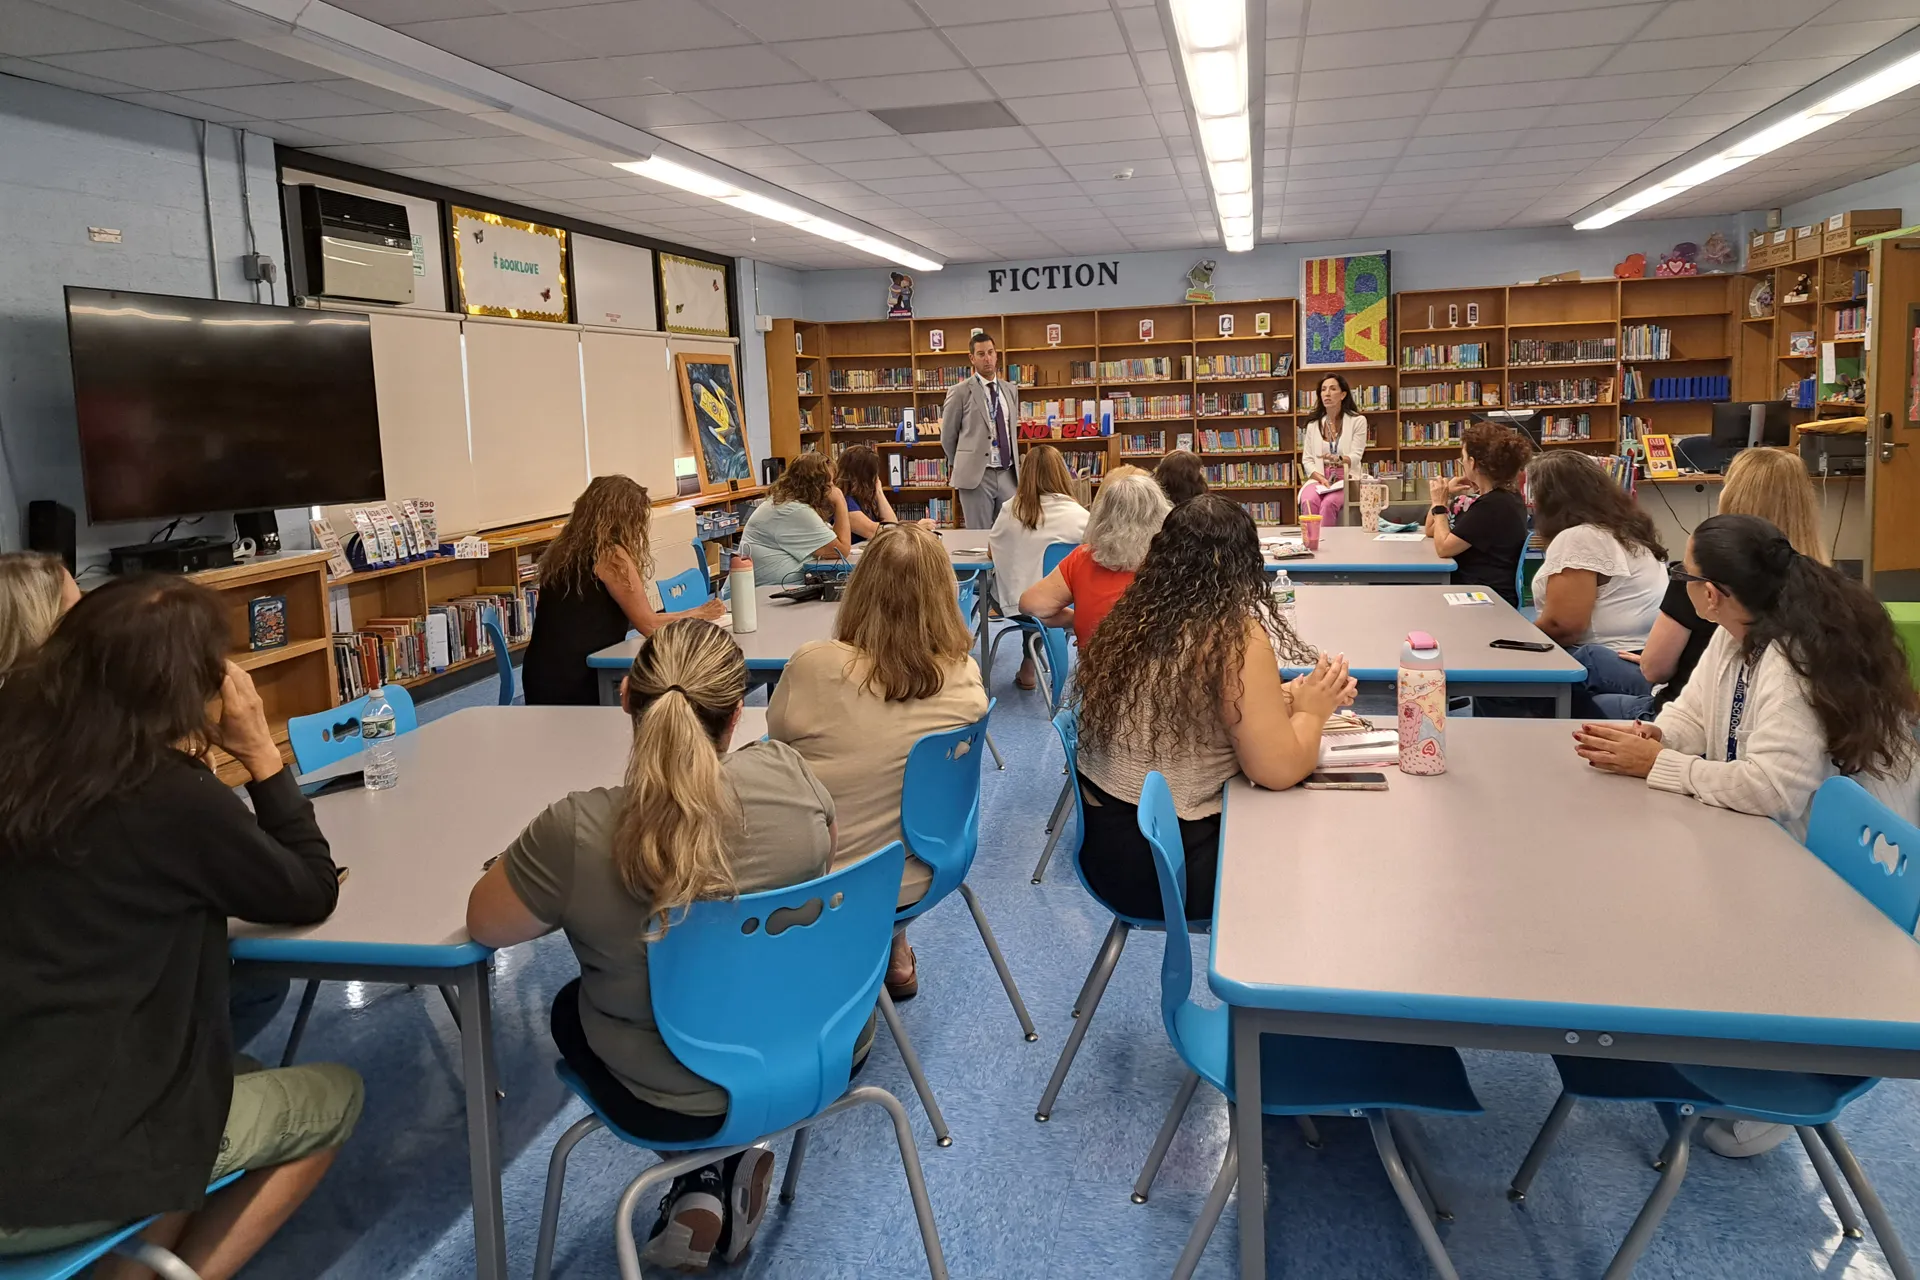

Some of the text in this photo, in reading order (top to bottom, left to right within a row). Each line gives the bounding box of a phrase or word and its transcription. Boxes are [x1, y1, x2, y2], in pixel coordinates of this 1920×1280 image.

[988, 261, 1120, 293] FICTION
[1018, 418, 1099, 439] Noels
[1730, 701, 1744, 738] Schools
